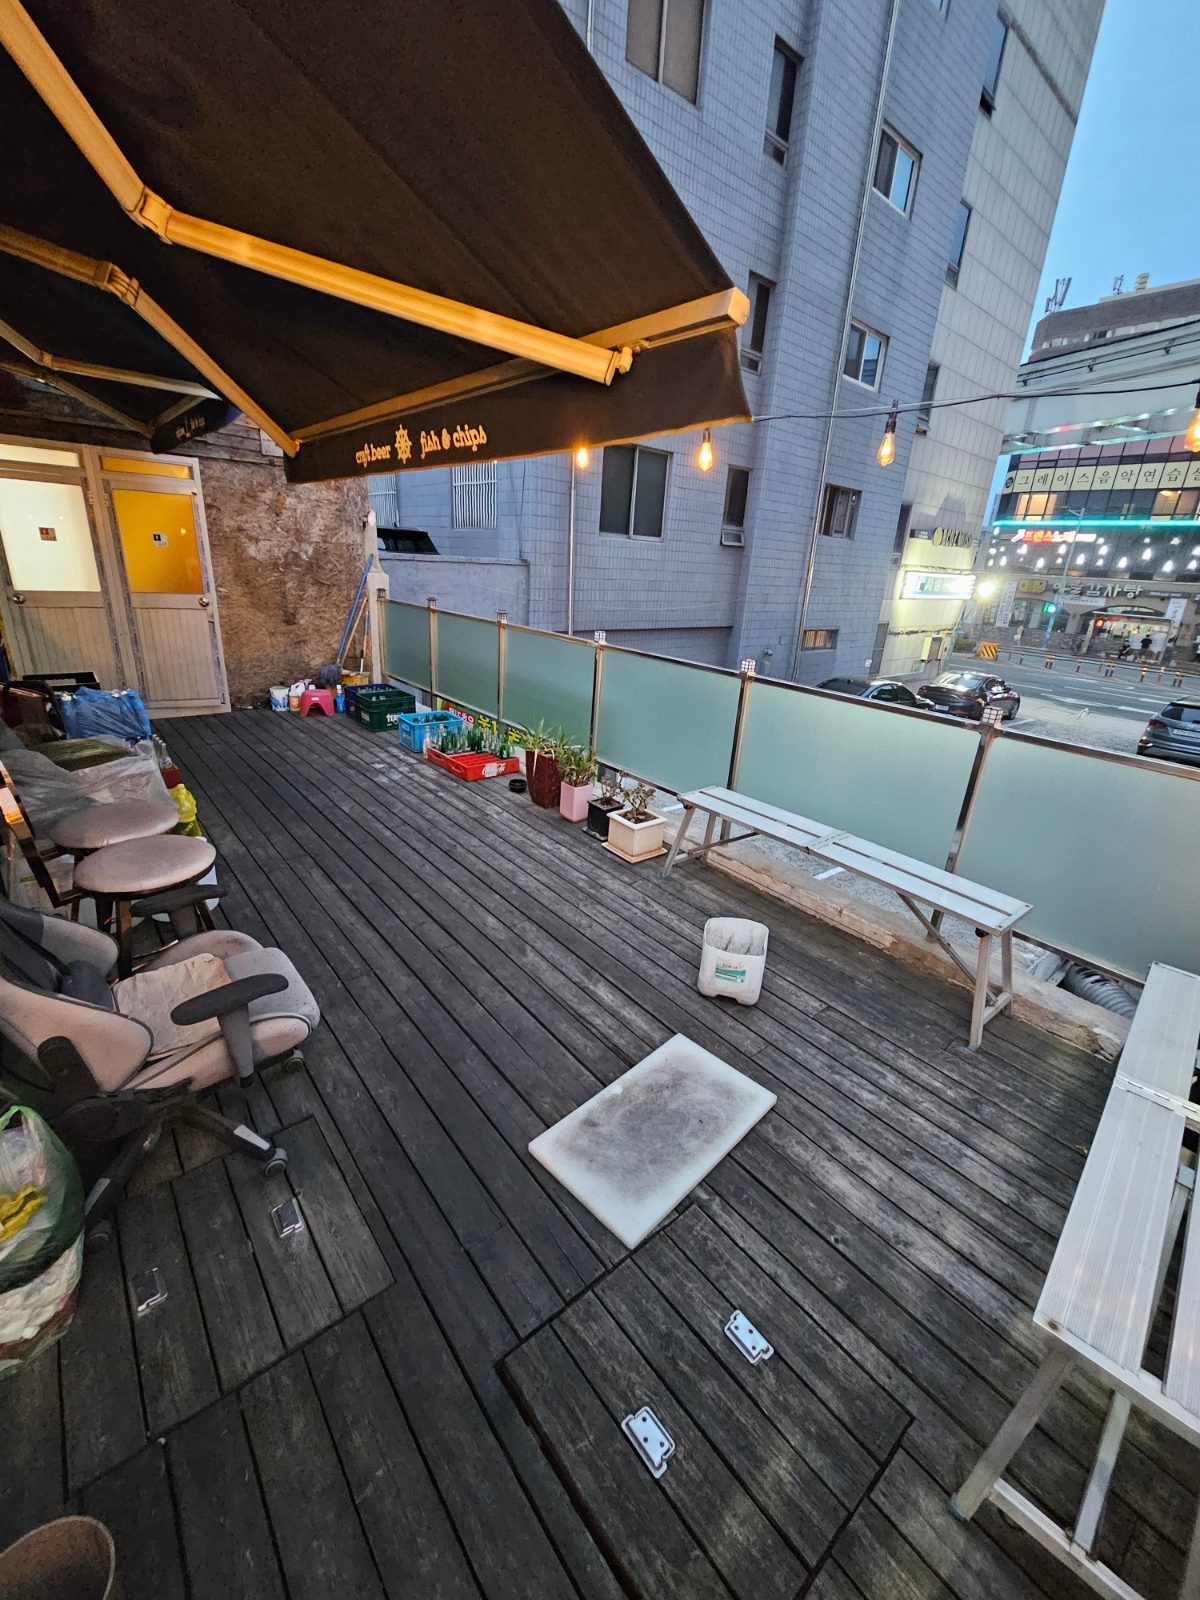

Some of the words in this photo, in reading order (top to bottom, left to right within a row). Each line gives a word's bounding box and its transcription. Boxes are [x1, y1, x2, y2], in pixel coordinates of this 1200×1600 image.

[371, 442, 391, 461] beer
[420, 430, 441, 460] fish
[453, 424, 488, 452] chips
